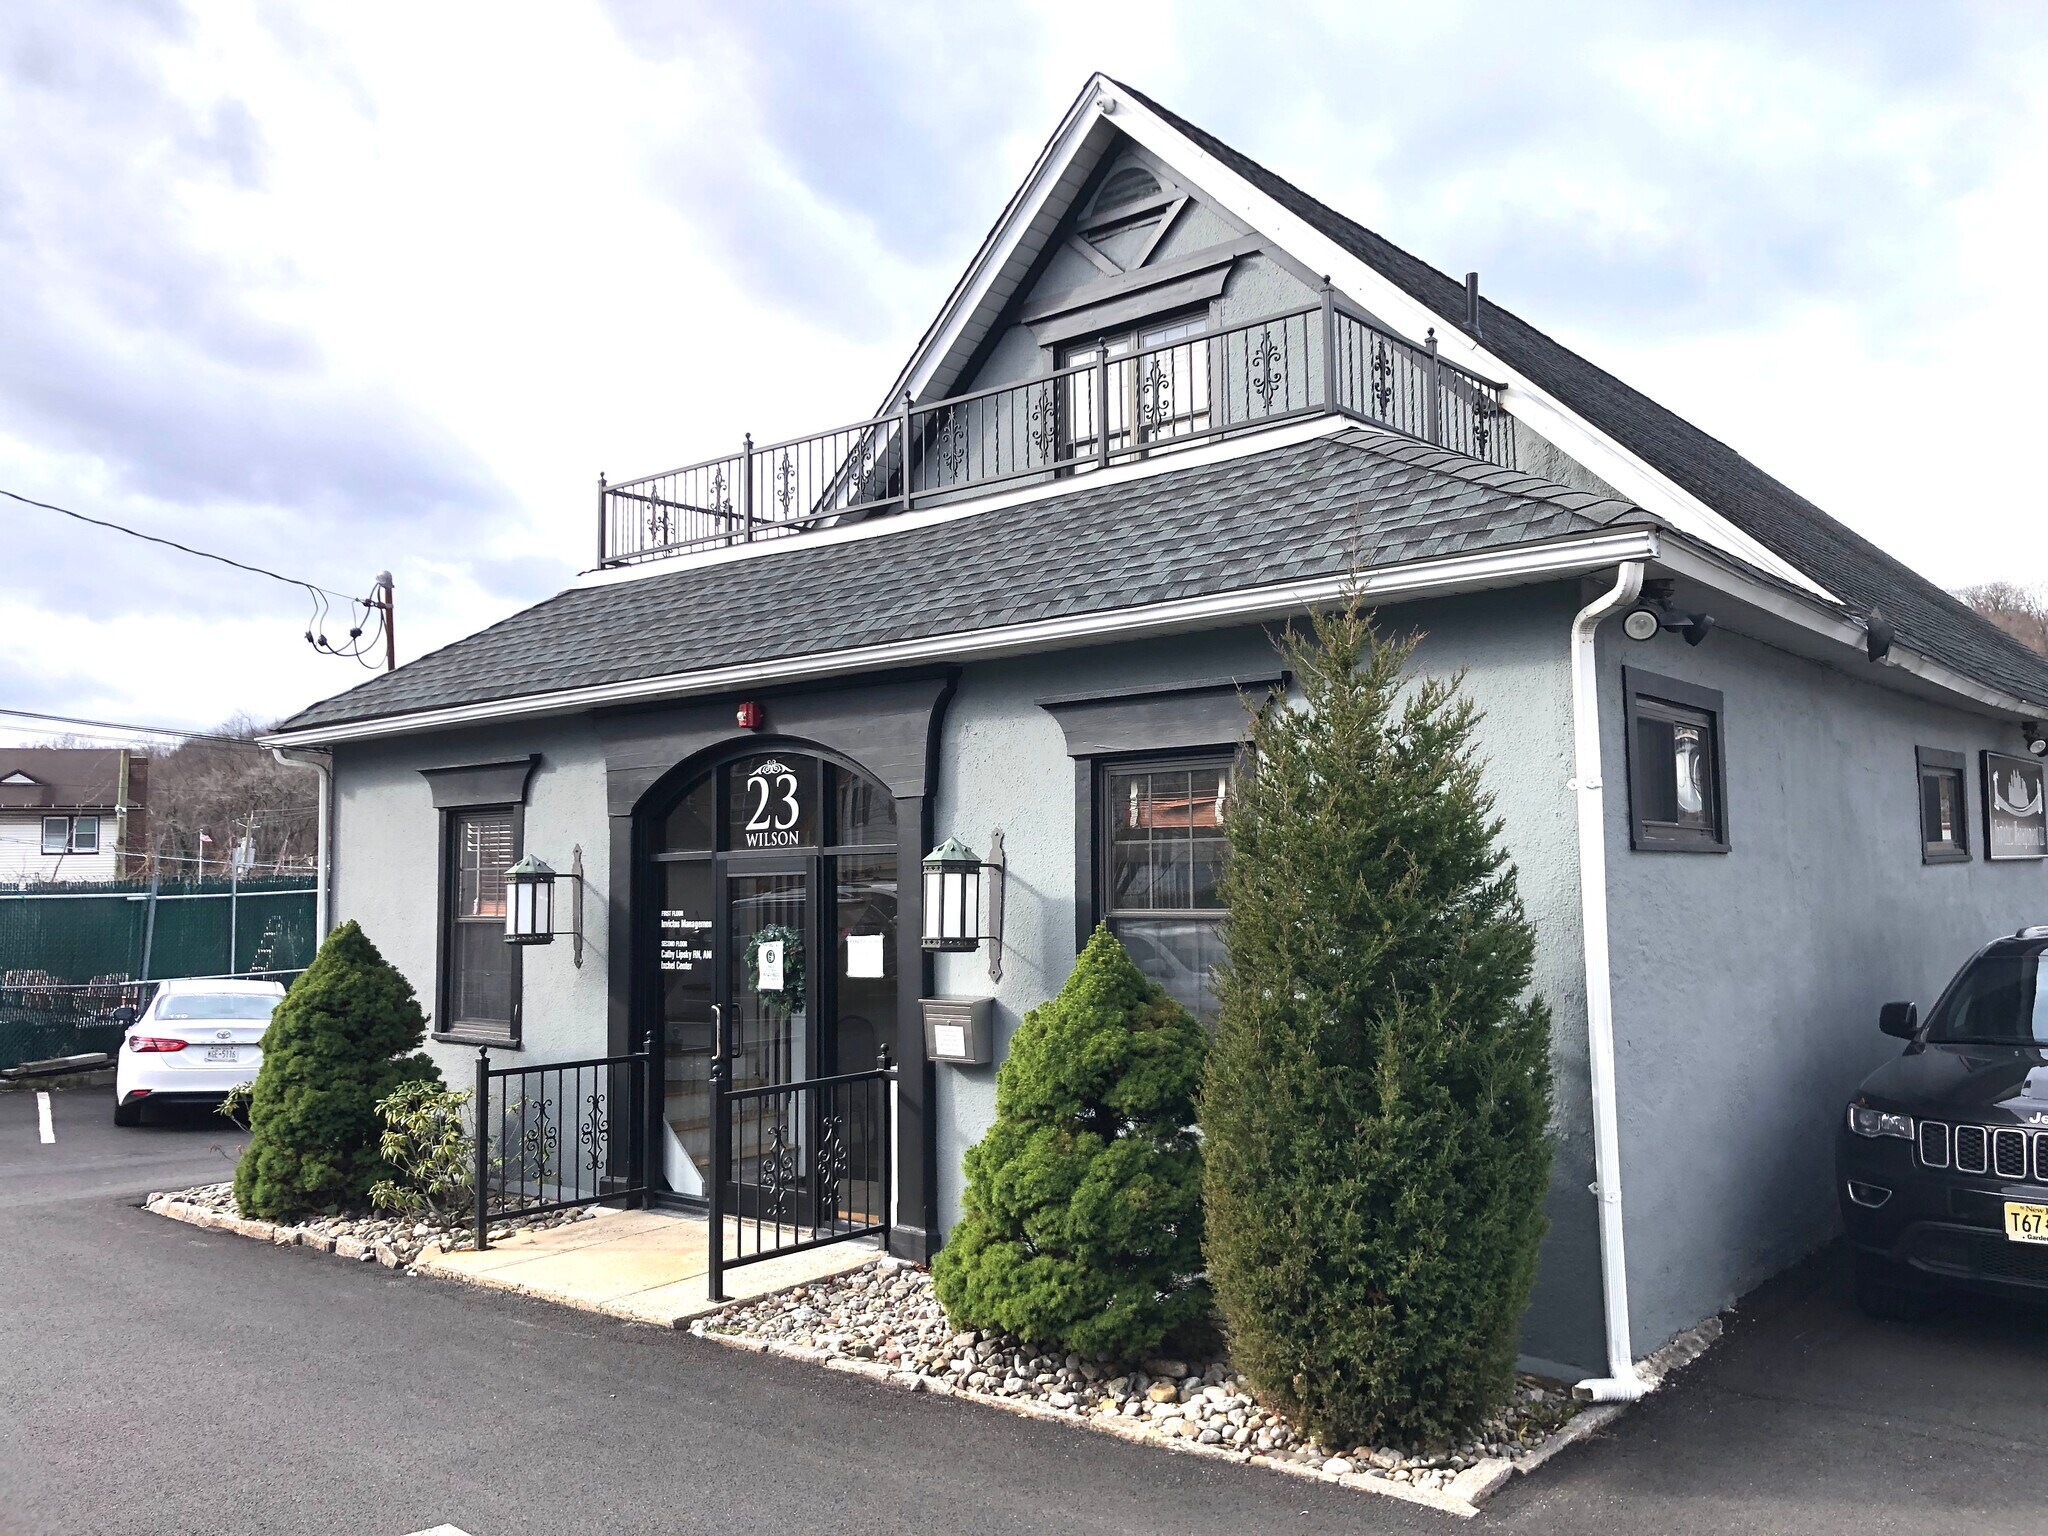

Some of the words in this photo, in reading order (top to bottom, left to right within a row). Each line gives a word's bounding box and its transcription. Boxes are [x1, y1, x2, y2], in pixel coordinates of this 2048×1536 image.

[745, 773, 799, 831] 23
[745, 830, 800, 847] WILSON
[661, 949, 675, 960] Cathy
[676, 961, 693, 970] Center
[2010, 1212, 2042, 1234] T67
